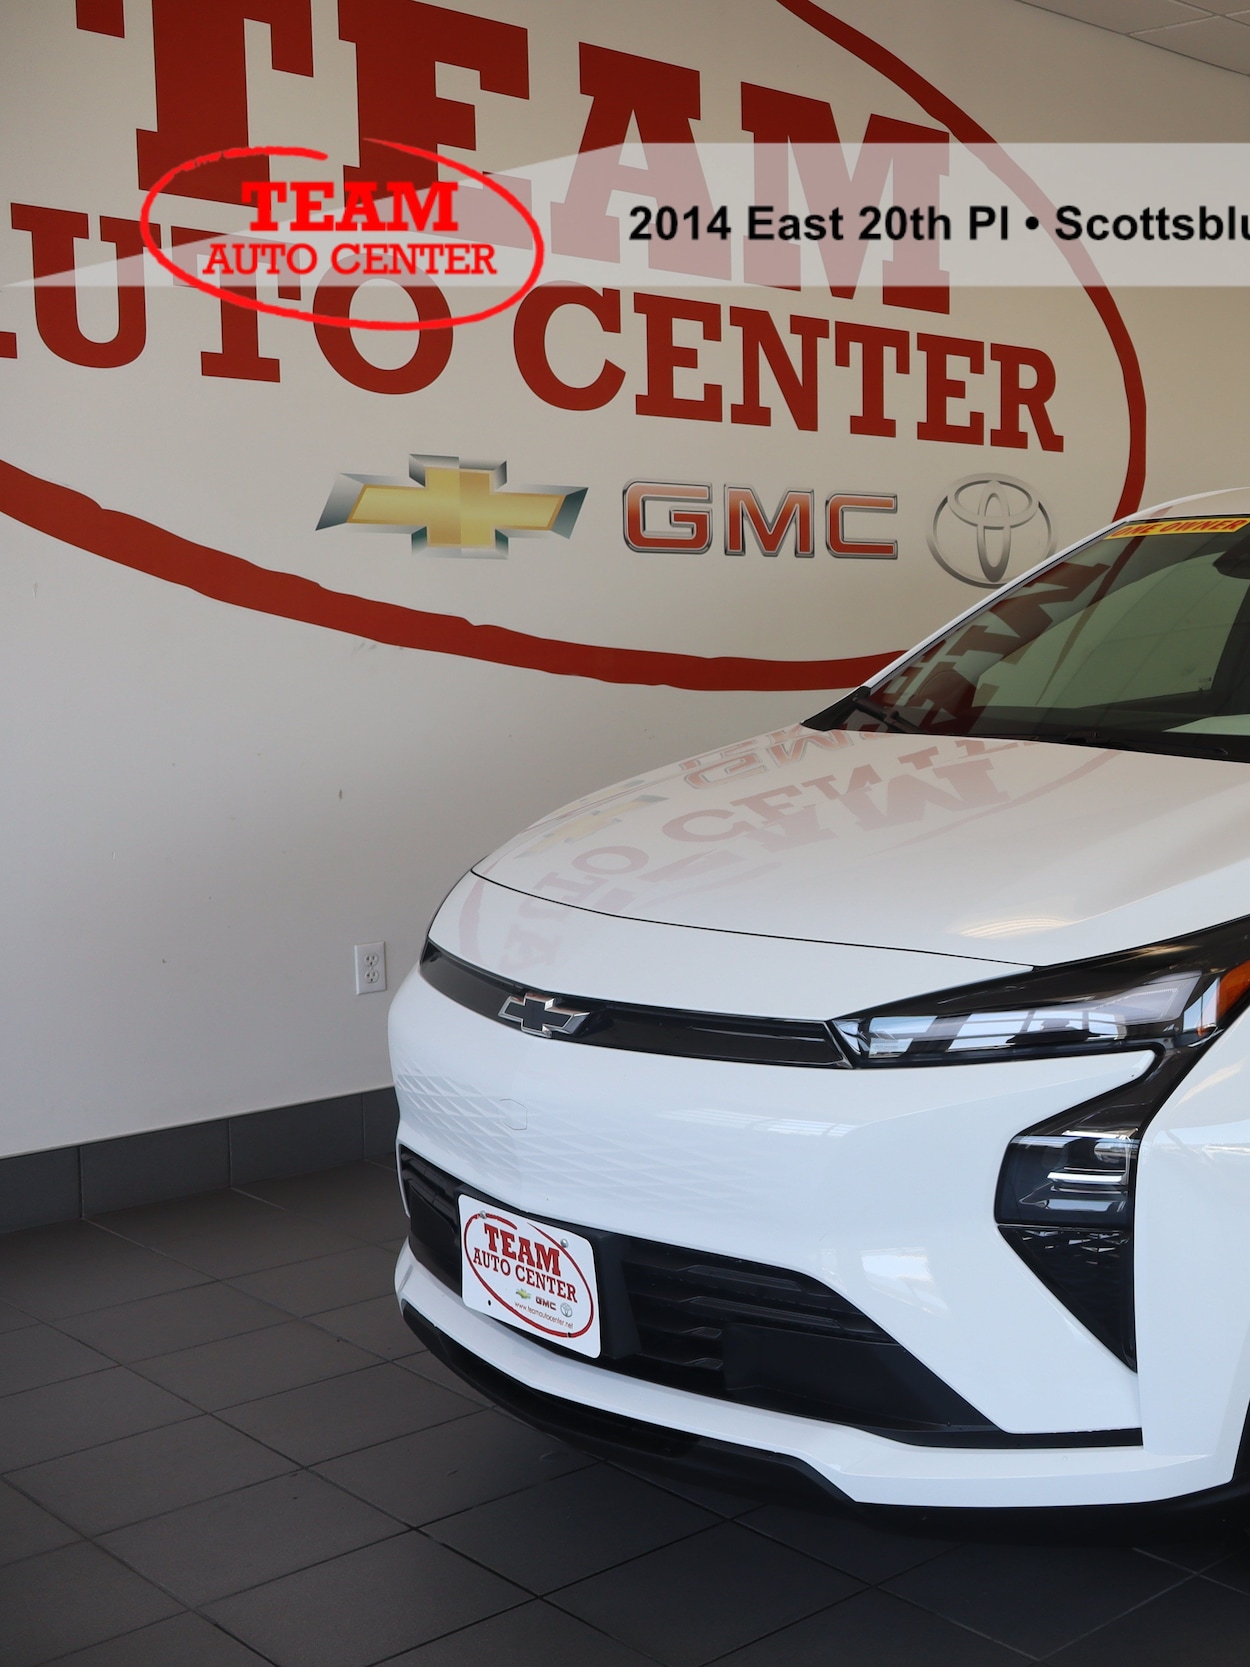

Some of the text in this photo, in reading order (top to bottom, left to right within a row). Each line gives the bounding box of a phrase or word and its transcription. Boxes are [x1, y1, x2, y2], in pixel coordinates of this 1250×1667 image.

[0, 202, 1065, 453] UTO CENTER
[622, 480, 899, 561] GMC
[1110, 519, 1248, 538] ONE OWNER
[473, 1247, 578, 1304] AUTO CENTER
[484, 1223, 561, 1277] TEAM
[514, 1301, 573, 1329] www.teamautocenter.net
[536, 1296, 557, 1311] GMC
